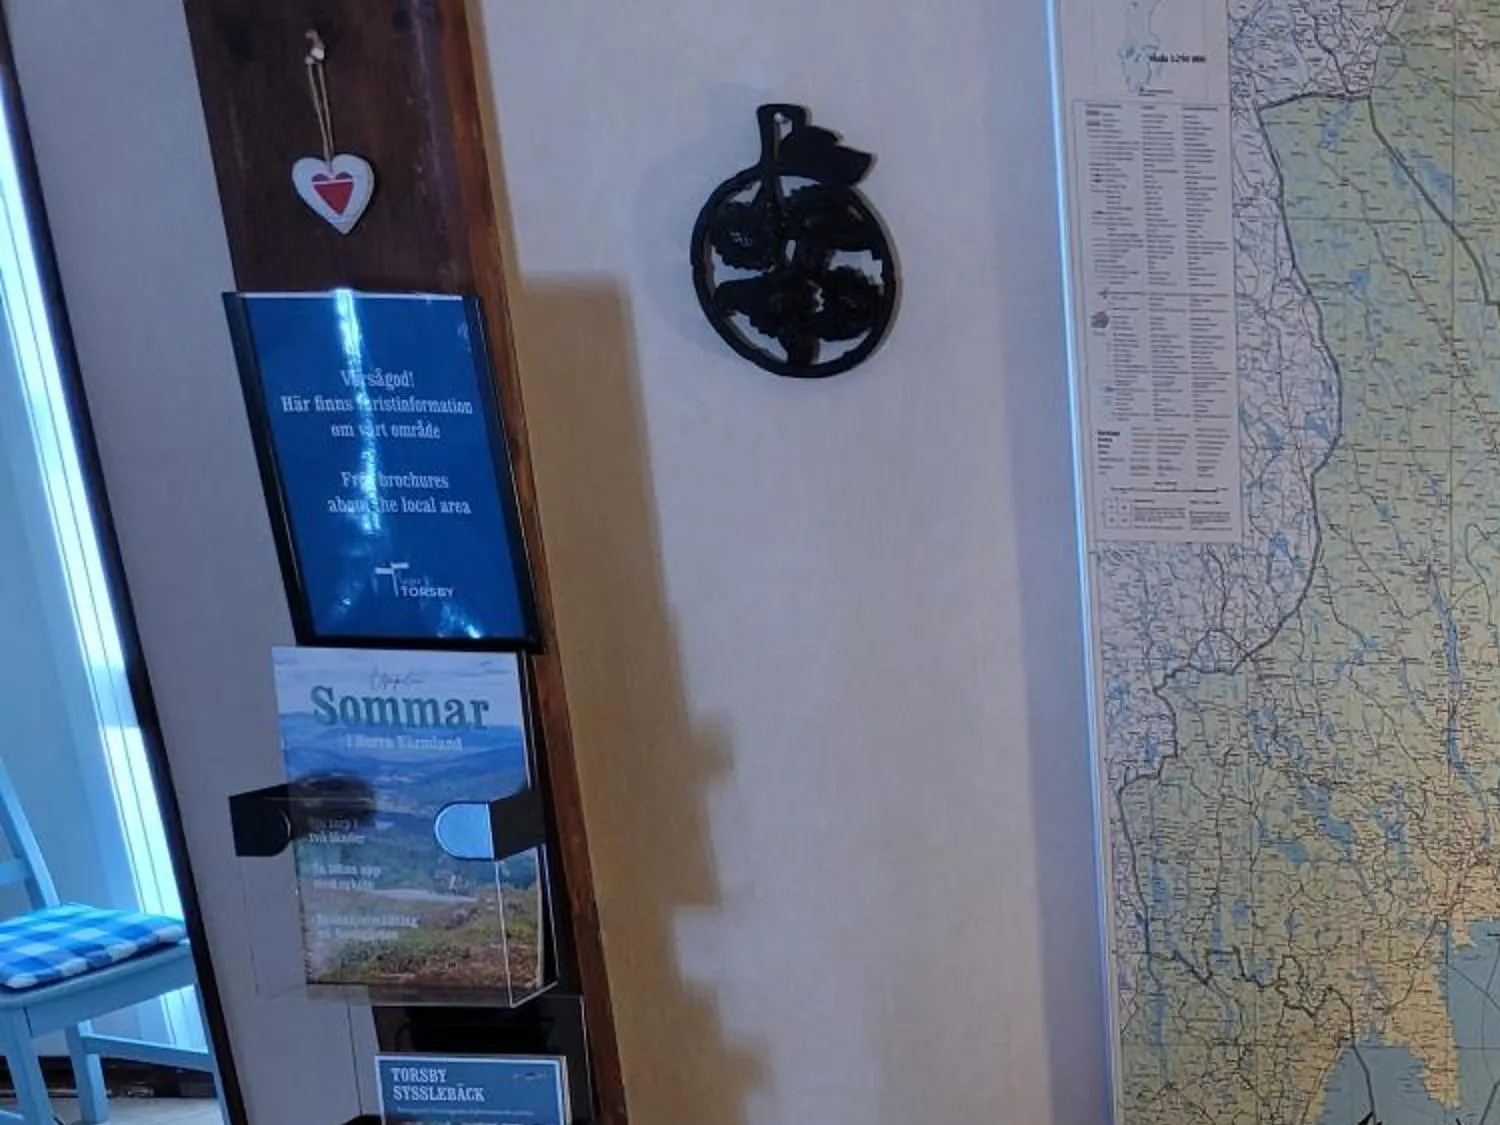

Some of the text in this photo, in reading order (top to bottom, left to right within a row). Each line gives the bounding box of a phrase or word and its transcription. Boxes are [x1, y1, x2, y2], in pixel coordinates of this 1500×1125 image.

[280, 395, 473, 414] Här finns uristinformation
[331, 425, 355, 437] om
[391, 420, 441, 438] område
[379, 472, 449, 489] brochures
[376, 497, 399, 513] the
[402, 496, 436, 513] local
[439, 500, 472, 514] area
[310, 685, 489, 731] Sommar
[390, 1067, 447, 1083] TORSBY
[393, 1082, 485, 1101] SYSSLEBÄCK
